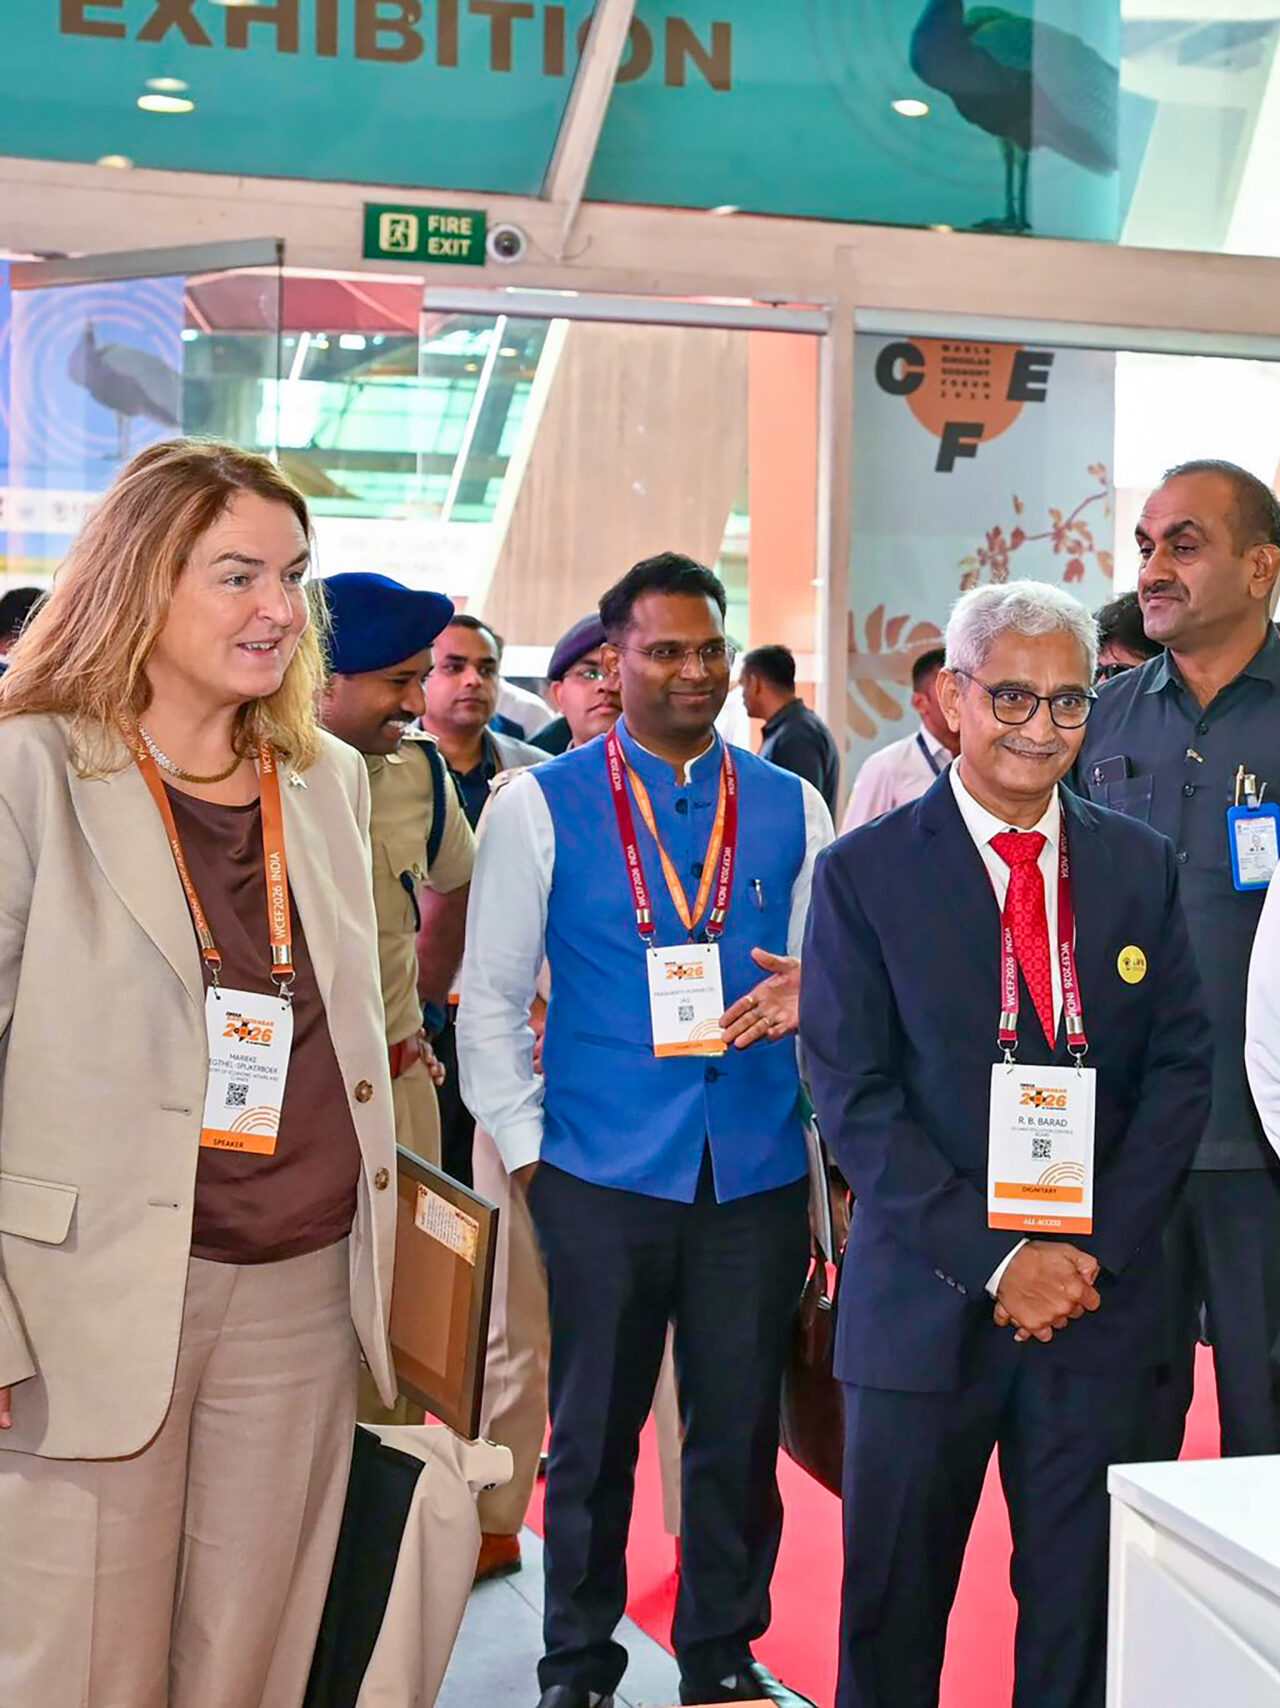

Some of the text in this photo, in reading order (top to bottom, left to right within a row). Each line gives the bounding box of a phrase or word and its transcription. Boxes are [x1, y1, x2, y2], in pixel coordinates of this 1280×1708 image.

[428, 215, 472, 235] FIRE
[428, 236, 472, 257] EXIT
[269, 851, 286, 940] WCEF2026 INDIA
[1004, 927, 1016, 1007] WCEF2026 INDIA
[1060, 941, 1074, 989] WCEF2026
[1018, 1116, 1068, 1127] R. B. BARAD
[213, 1138, 244, 1148] SPEAKER
[1022, 1186, 1057, 1194] DIGNITARY
[1023, 1217, 1036, 1225] ALL
